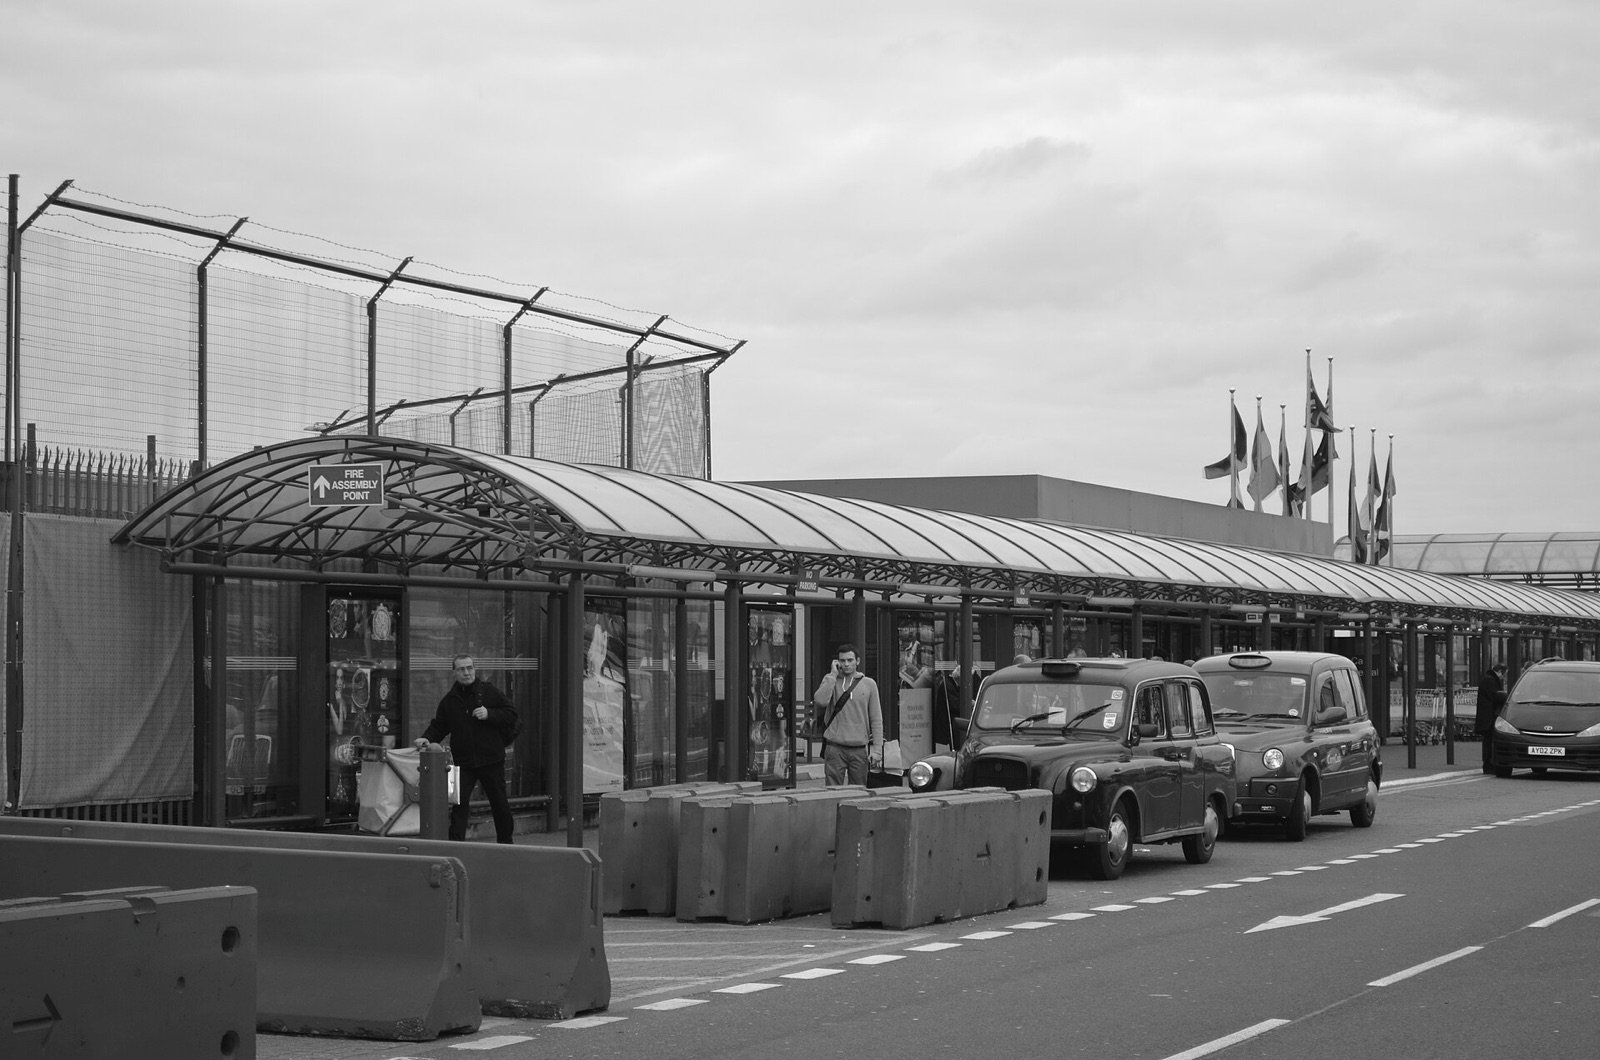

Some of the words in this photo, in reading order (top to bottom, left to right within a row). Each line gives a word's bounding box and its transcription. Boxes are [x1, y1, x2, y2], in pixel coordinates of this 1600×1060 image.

[344, 469, 364, 479] FIRE
[331, 480, 378, 490] ASSEMBLY
[343, 491, 370, 500] POINT
[805, 570, 813, 579] NO
[799, 581, 817, 590] PARKING
[1549, 747, 1563, 755] ZPK
